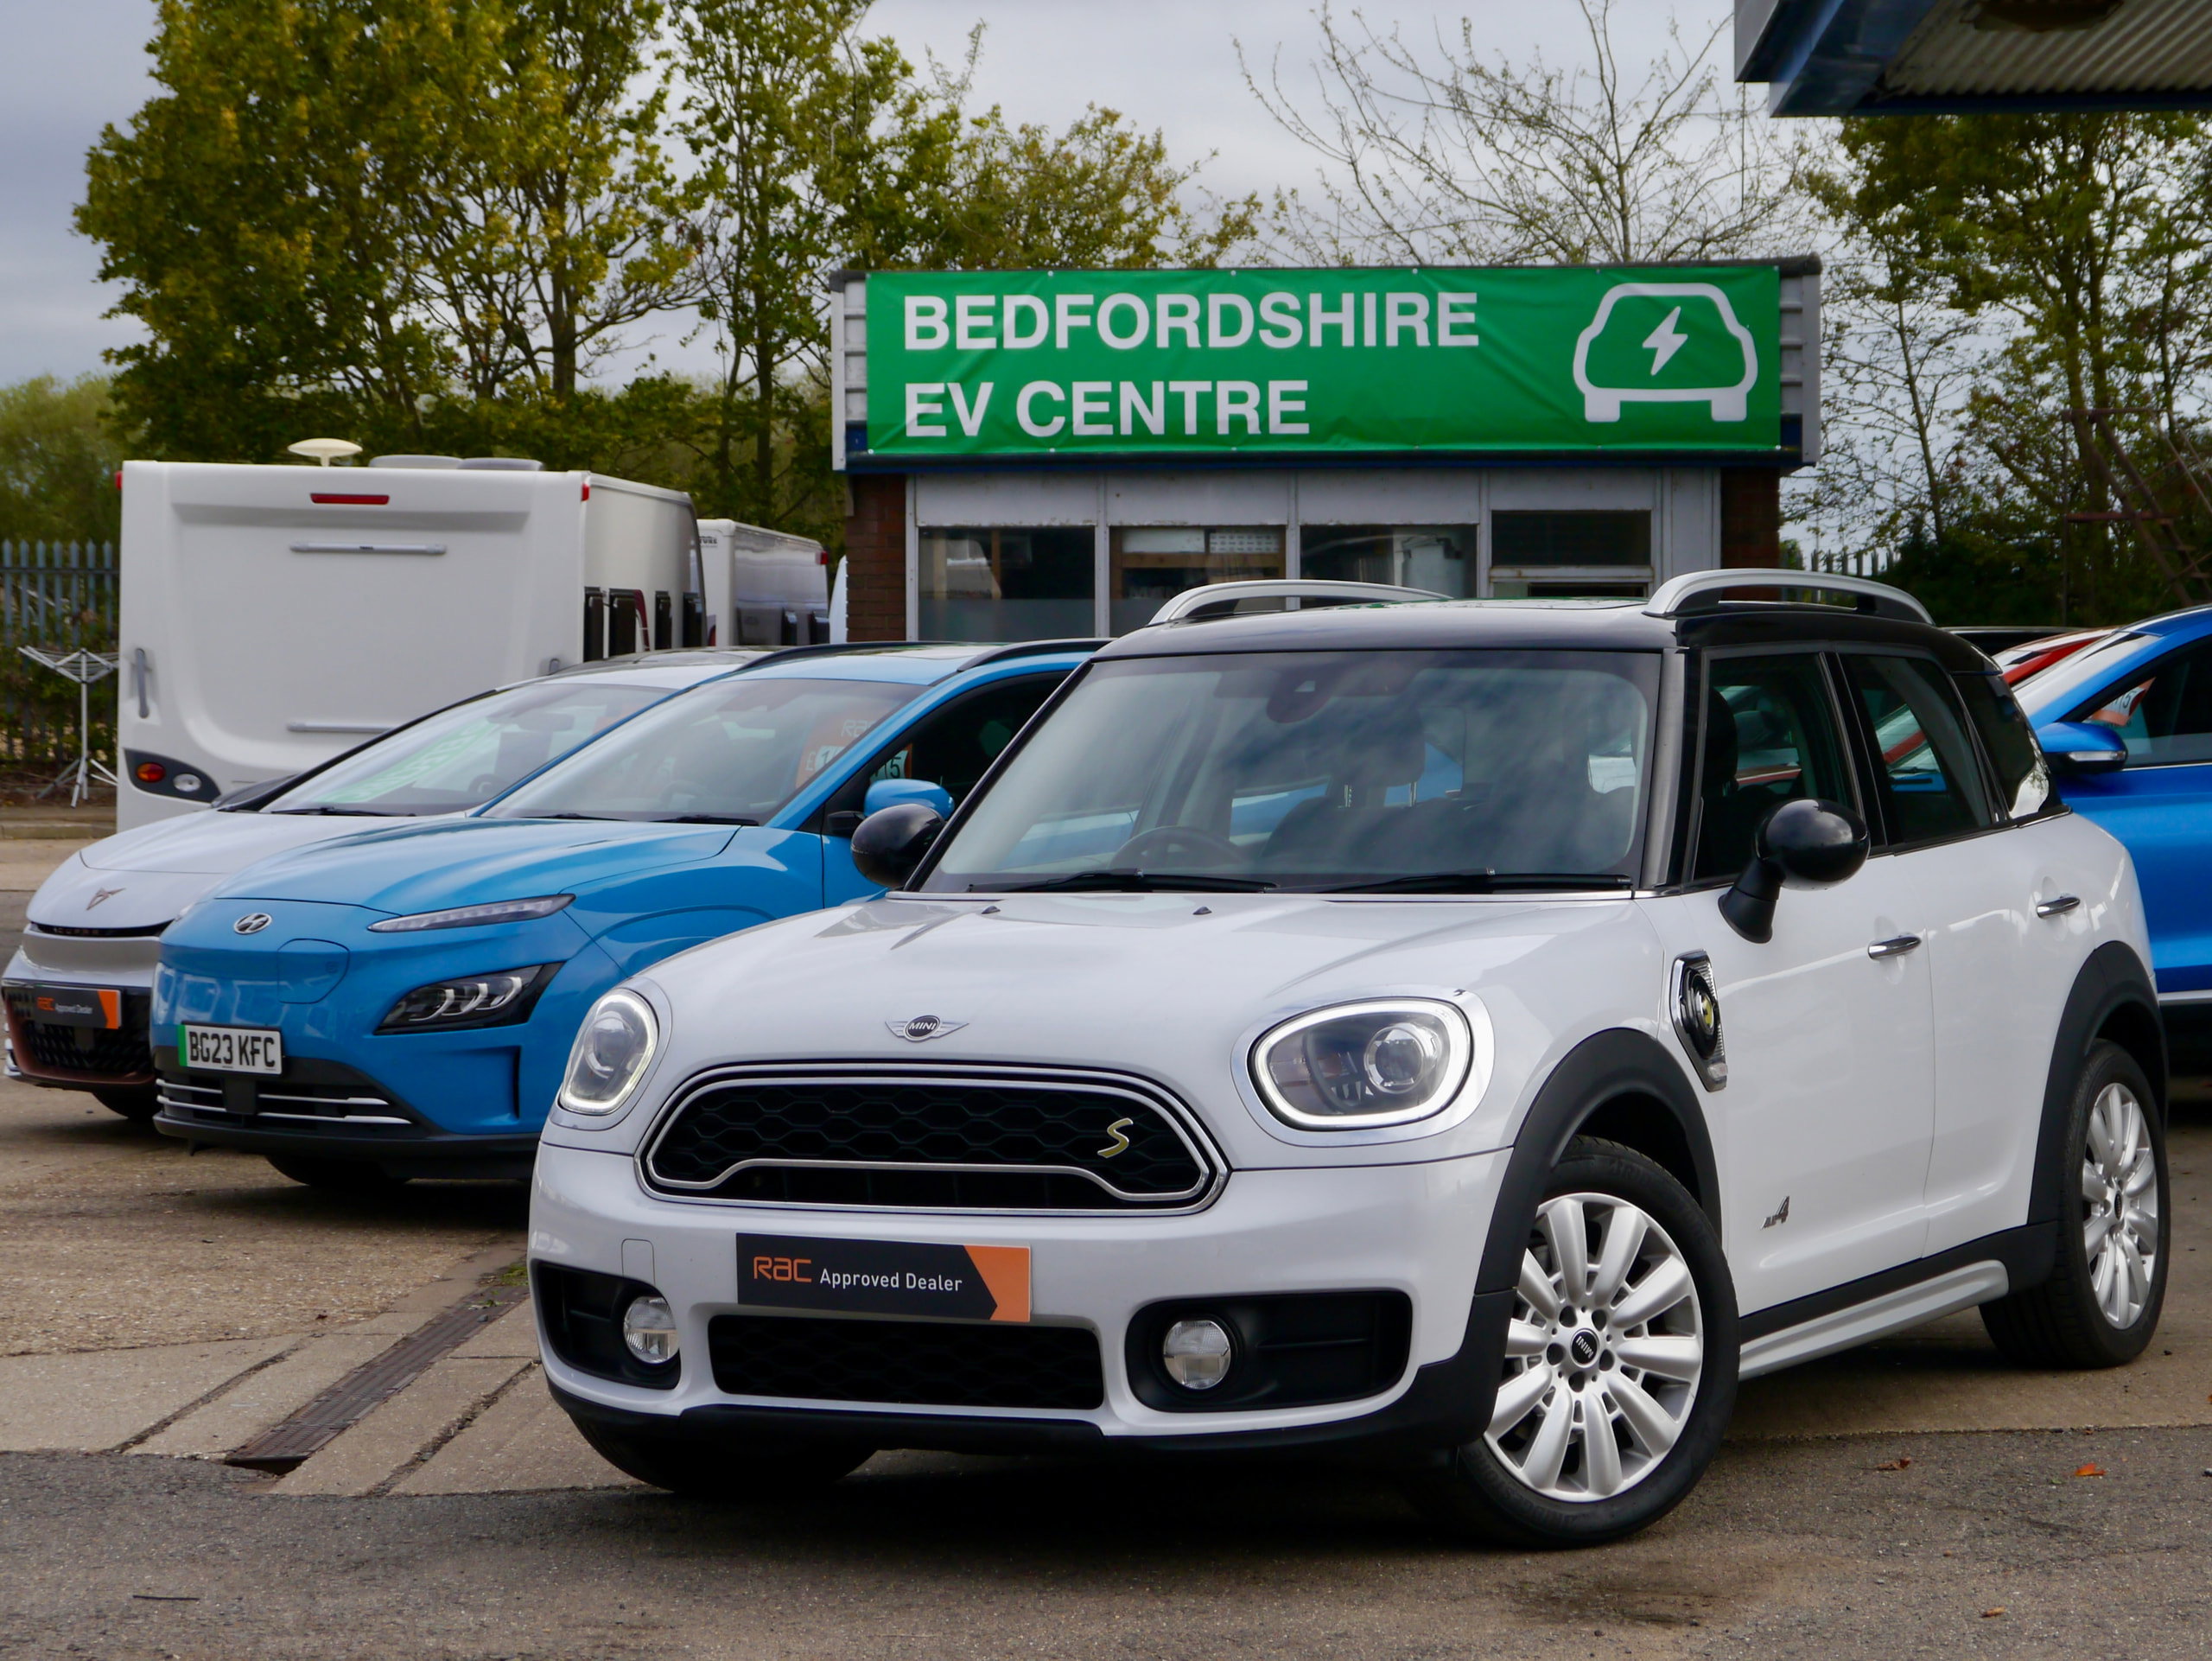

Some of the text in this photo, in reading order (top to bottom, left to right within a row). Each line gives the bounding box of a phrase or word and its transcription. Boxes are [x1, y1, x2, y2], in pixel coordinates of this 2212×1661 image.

[905, 292, 1478, 349] BEDFORDSHIRE
[906, 381, 1308, 436] EV CENTRE
[909, 1022, 938, 1031] MINI
[189, 1031, 275, 1067] BG23 KFC
[1097, 1117, 1134, 1159] S
[820, 1268, 899, 1289] Approved
[906, 1273, 963, 1292] Dealer
[1575, 1335, 1594, 1359] MINI
